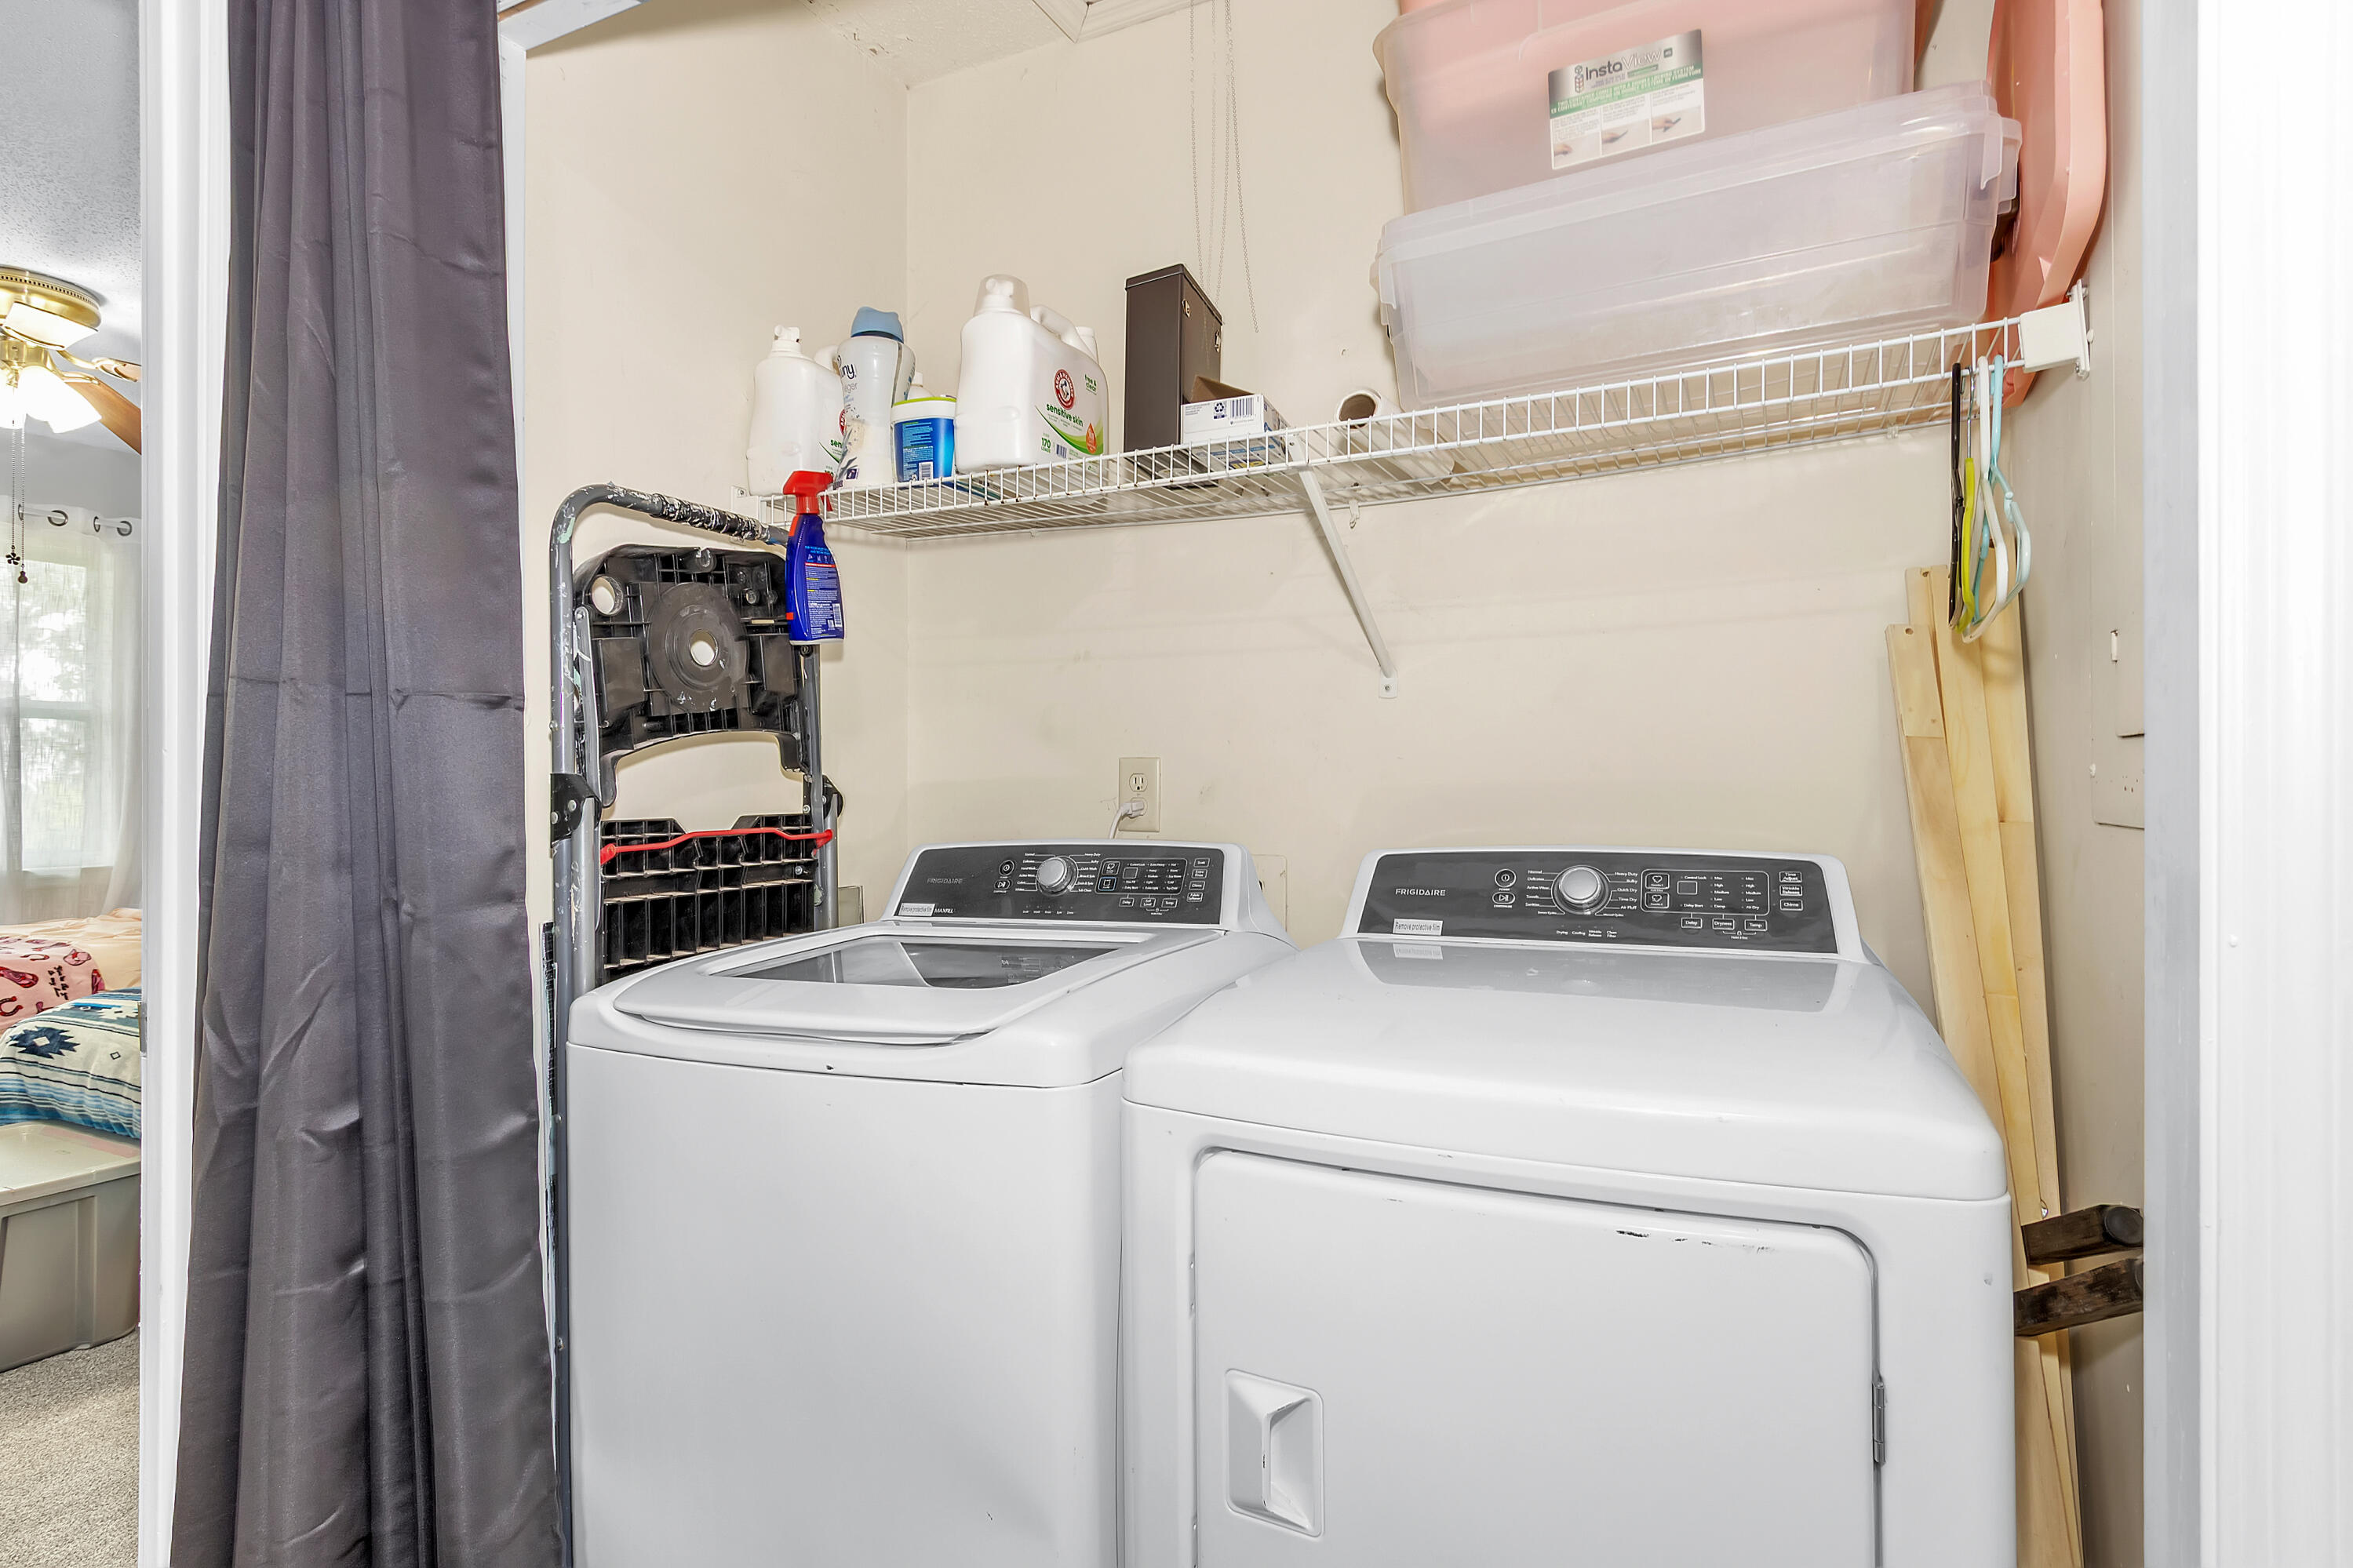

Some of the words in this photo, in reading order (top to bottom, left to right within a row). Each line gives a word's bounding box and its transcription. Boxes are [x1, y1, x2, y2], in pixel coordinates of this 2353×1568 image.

[1585, 49, 1662, 81] InstaView
[1046, 403, 1072, 421] sensitive
[1073, 415, 1084, 427] skin
[1041, 437, 1051, 449] 170
[1395, 888, 1446, 897] FRIGIDAIRE
[1395, 922, 1411, 931] Remove
[1411, 922, 1433, 932] protective
